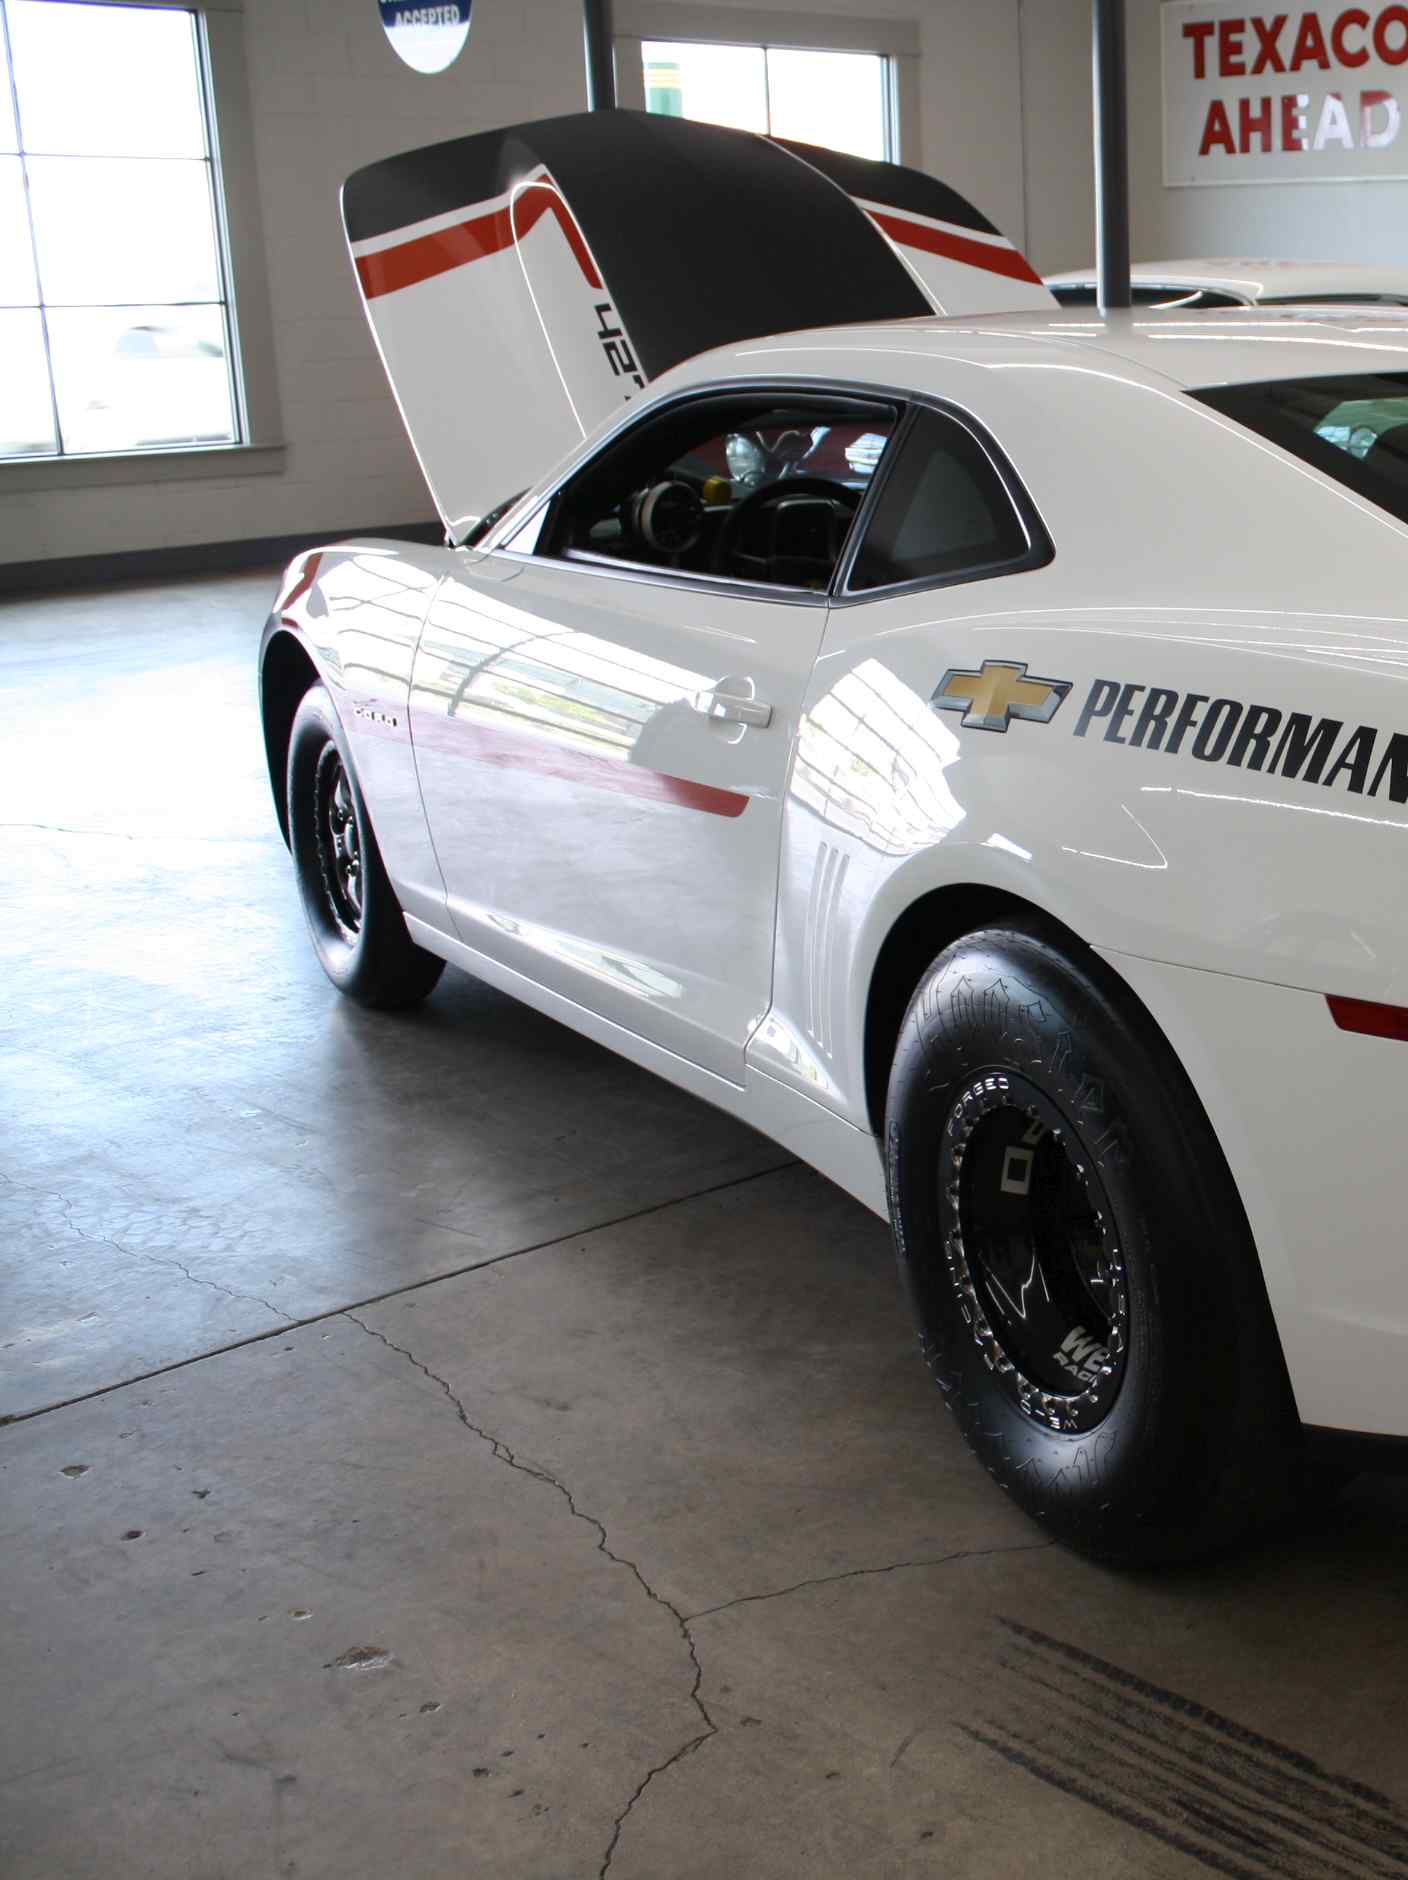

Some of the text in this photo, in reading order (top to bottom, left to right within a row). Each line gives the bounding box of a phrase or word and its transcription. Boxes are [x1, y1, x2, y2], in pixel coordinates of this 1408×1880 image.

[394, 4, 461, 26] ACCEPTED
[1198, 90, 1401, 156] AHEAD
[593, 303, 646, 402] 42
